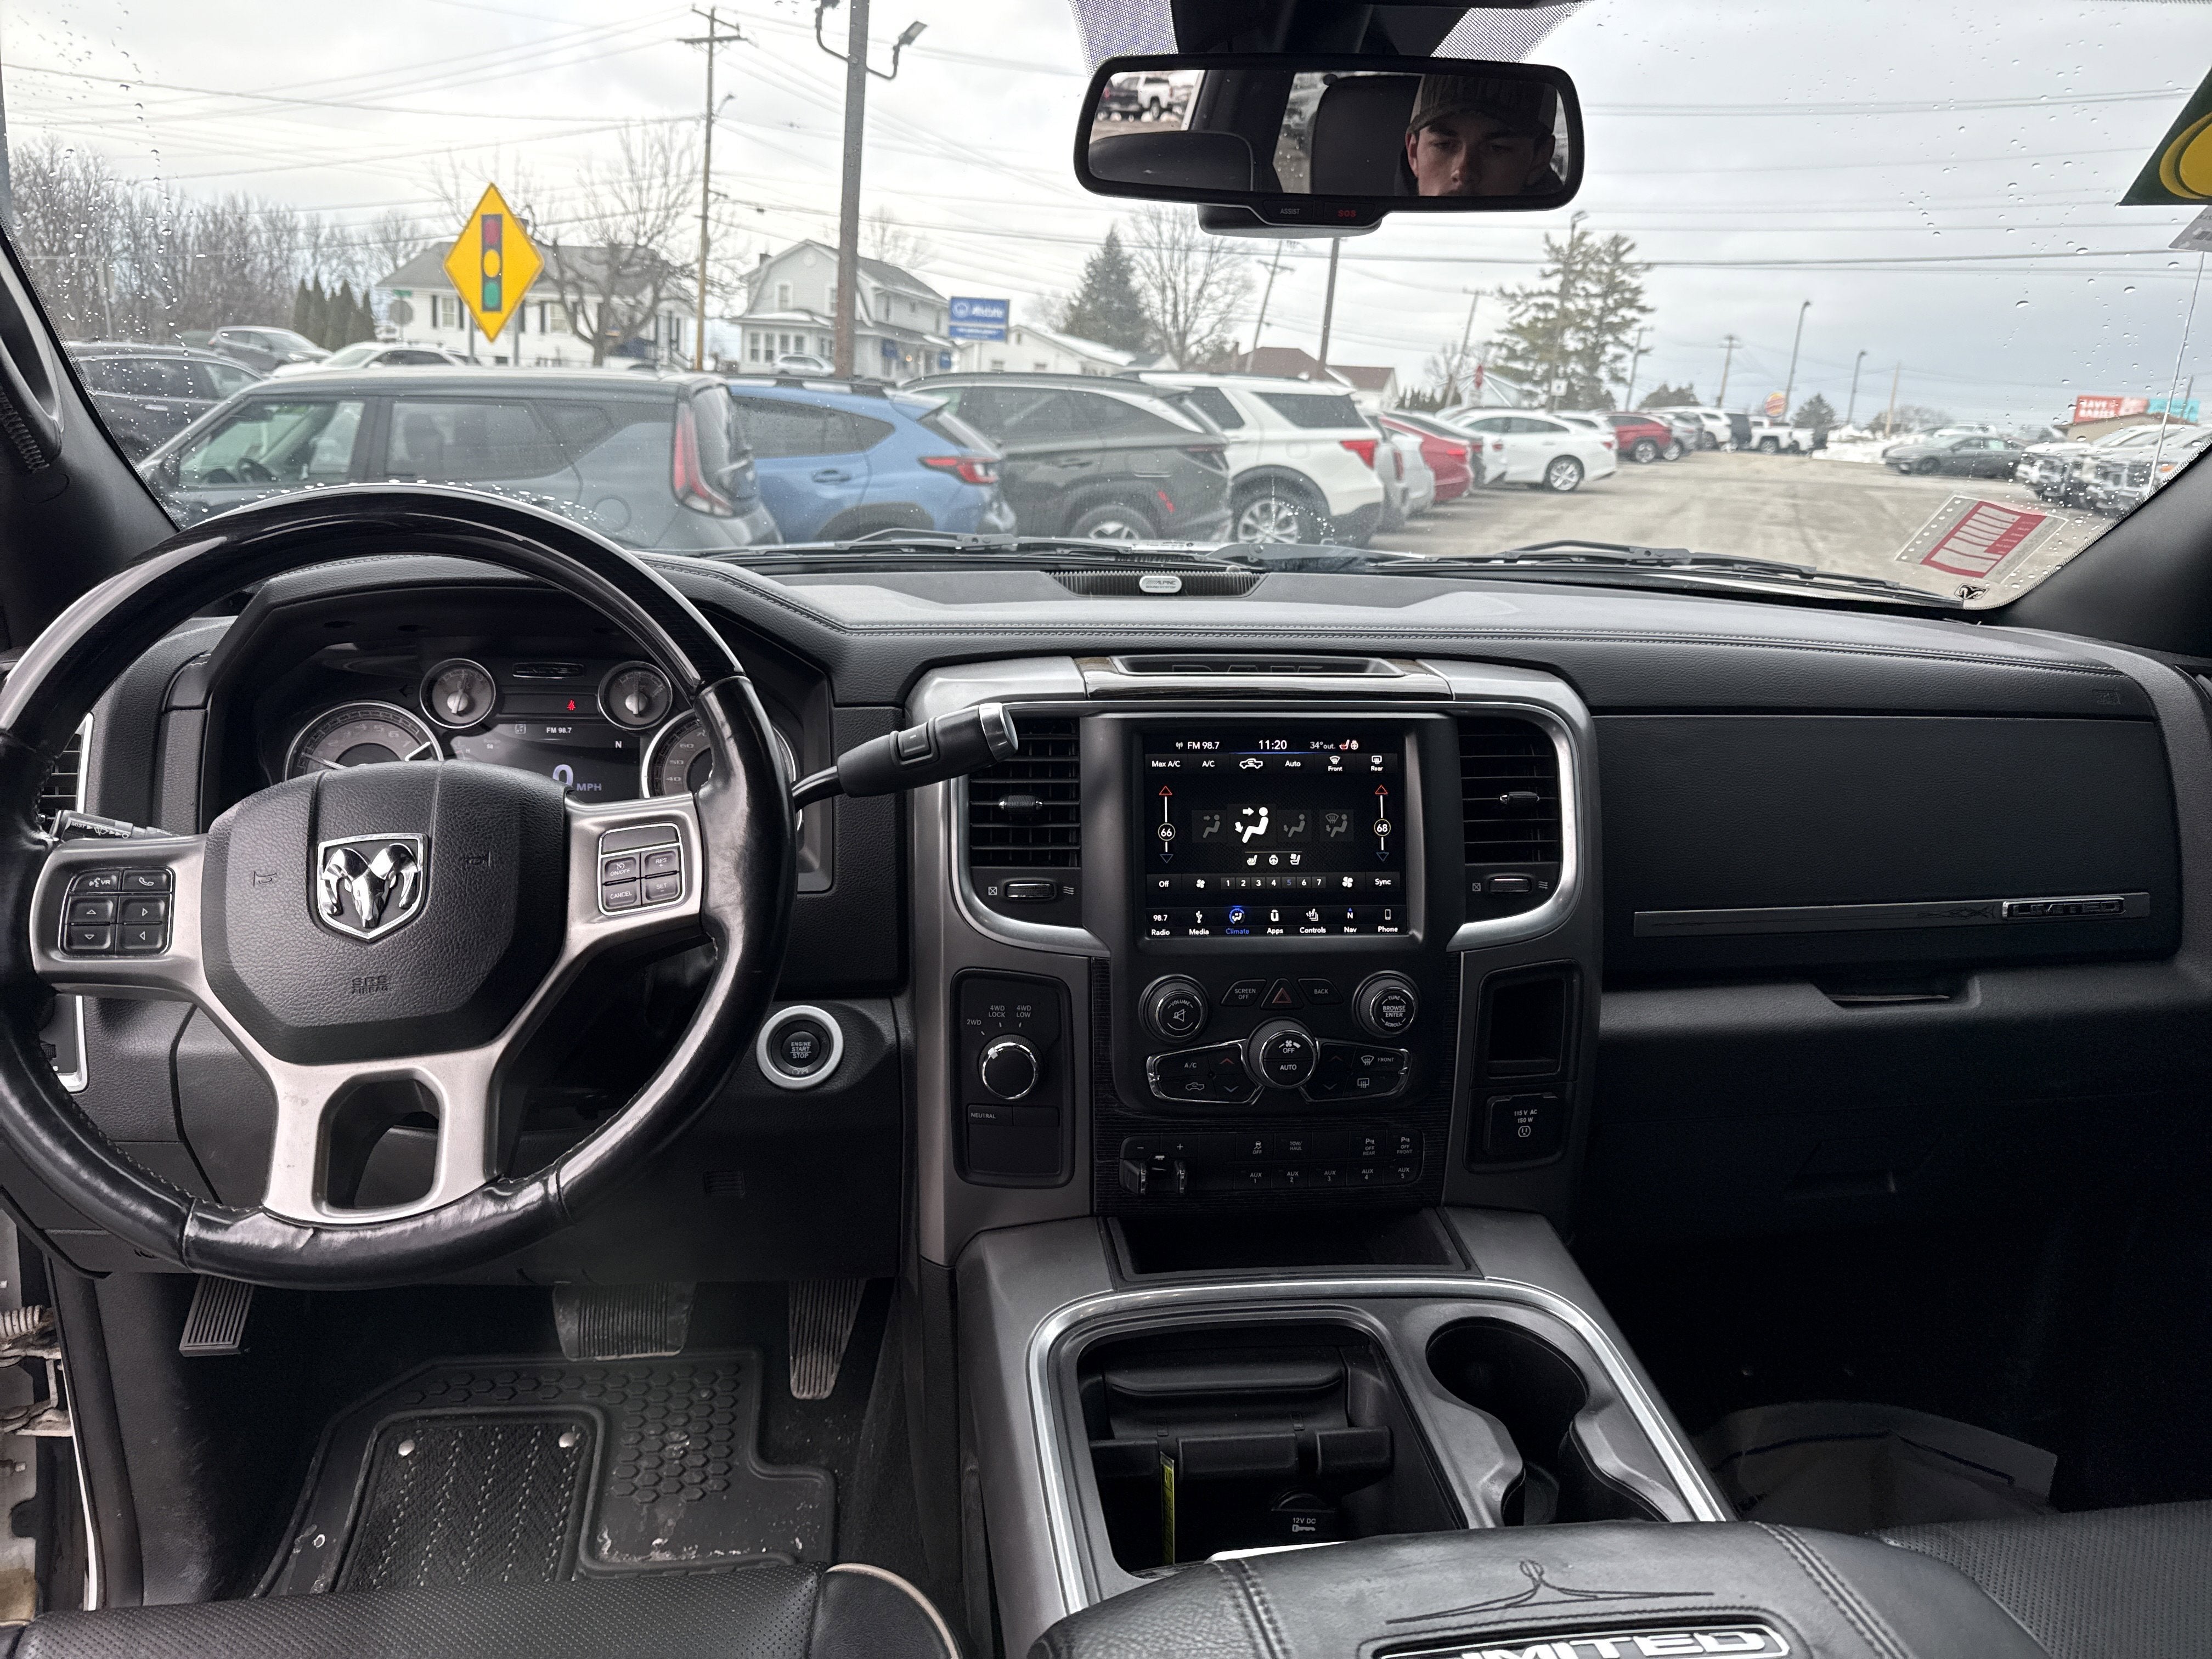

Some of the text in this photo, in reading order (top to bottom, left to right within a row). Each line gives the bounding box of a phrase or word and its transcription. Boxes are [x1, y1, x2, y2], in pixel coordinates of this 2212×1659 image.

[1187, 741, 1220, 749] FM 98.7
[1259, 740, 1288, 750] 11:20
[1376, 823, 1388, 832] 68
[1160, 828, 1172, 837] 66
[610, 868, 631, 877] ON/OFF
[1375, 878, 1391, 887] Sync
[610, 891, 632, 899] CANCEL
